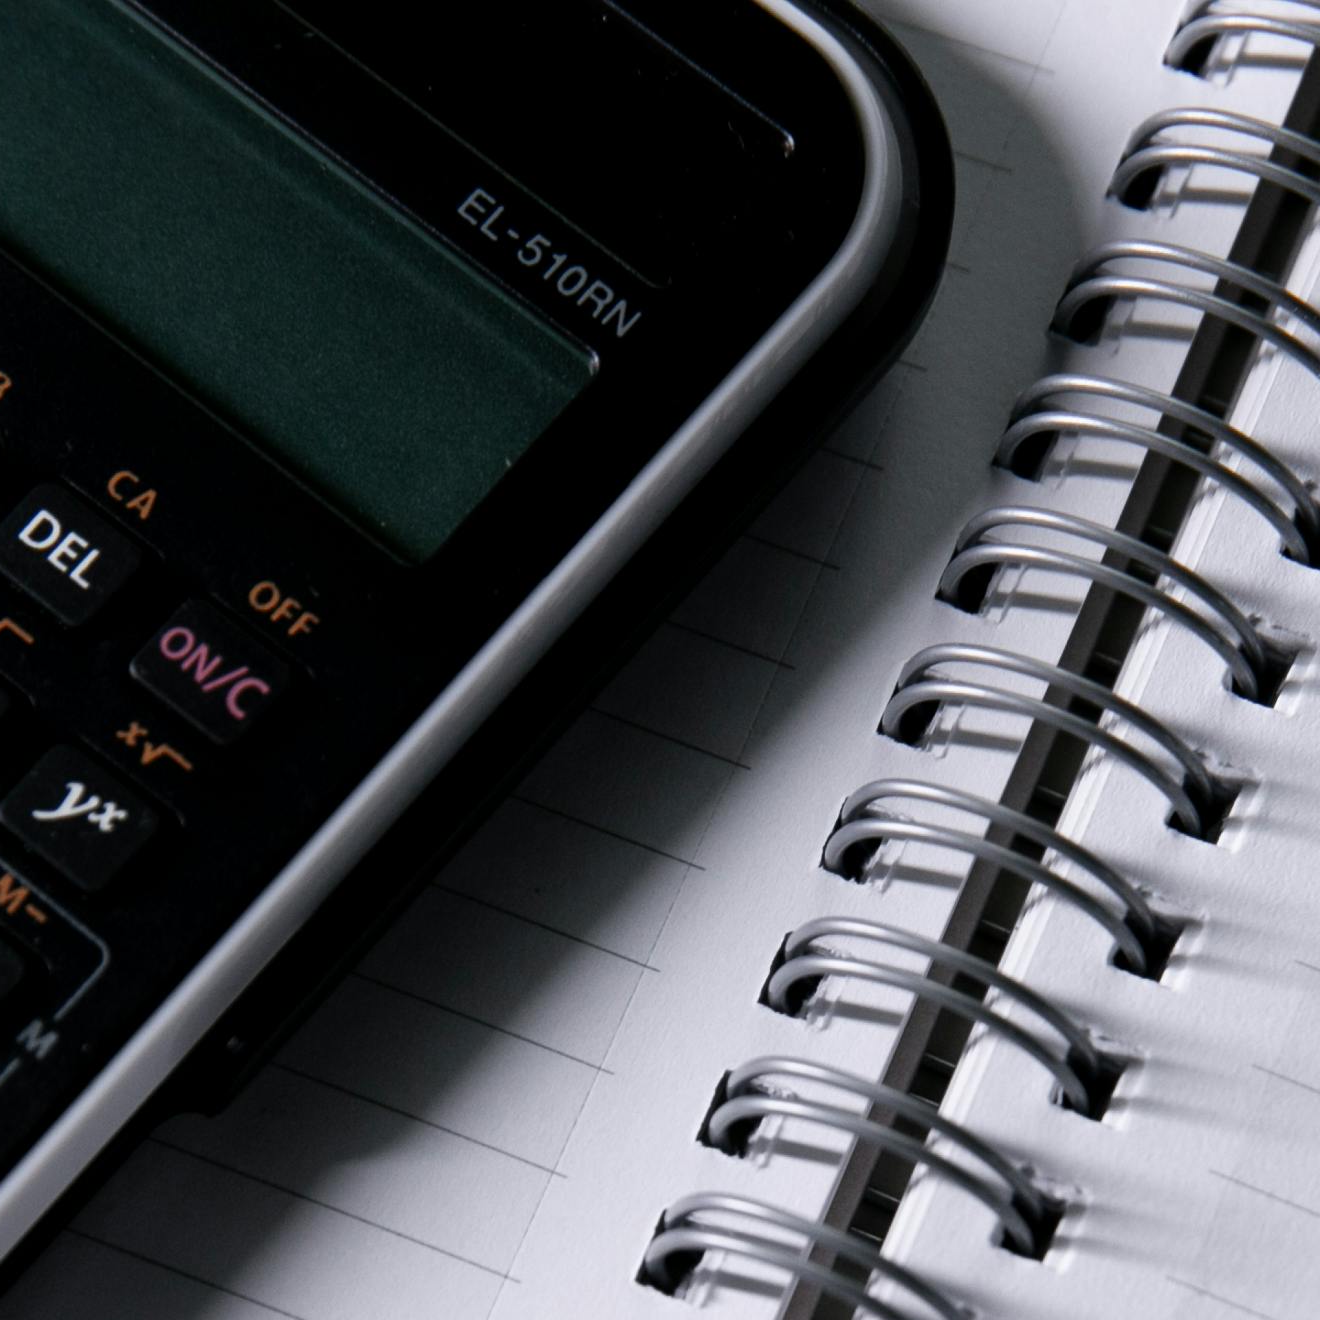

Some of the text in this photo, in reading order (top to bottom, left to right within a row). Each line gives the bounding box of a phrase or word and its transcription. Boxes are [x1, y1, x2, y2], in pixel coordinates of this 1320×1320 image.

[457, 188, 642, 338] EL-510RN
[107, 470, 157, 522] CA
[18, 508, 104, 590] DEL
[248, 581, 321, 637] OFF
[160, 627, 270, 720] ON/C
[16, 1018, 58, 1060] M
